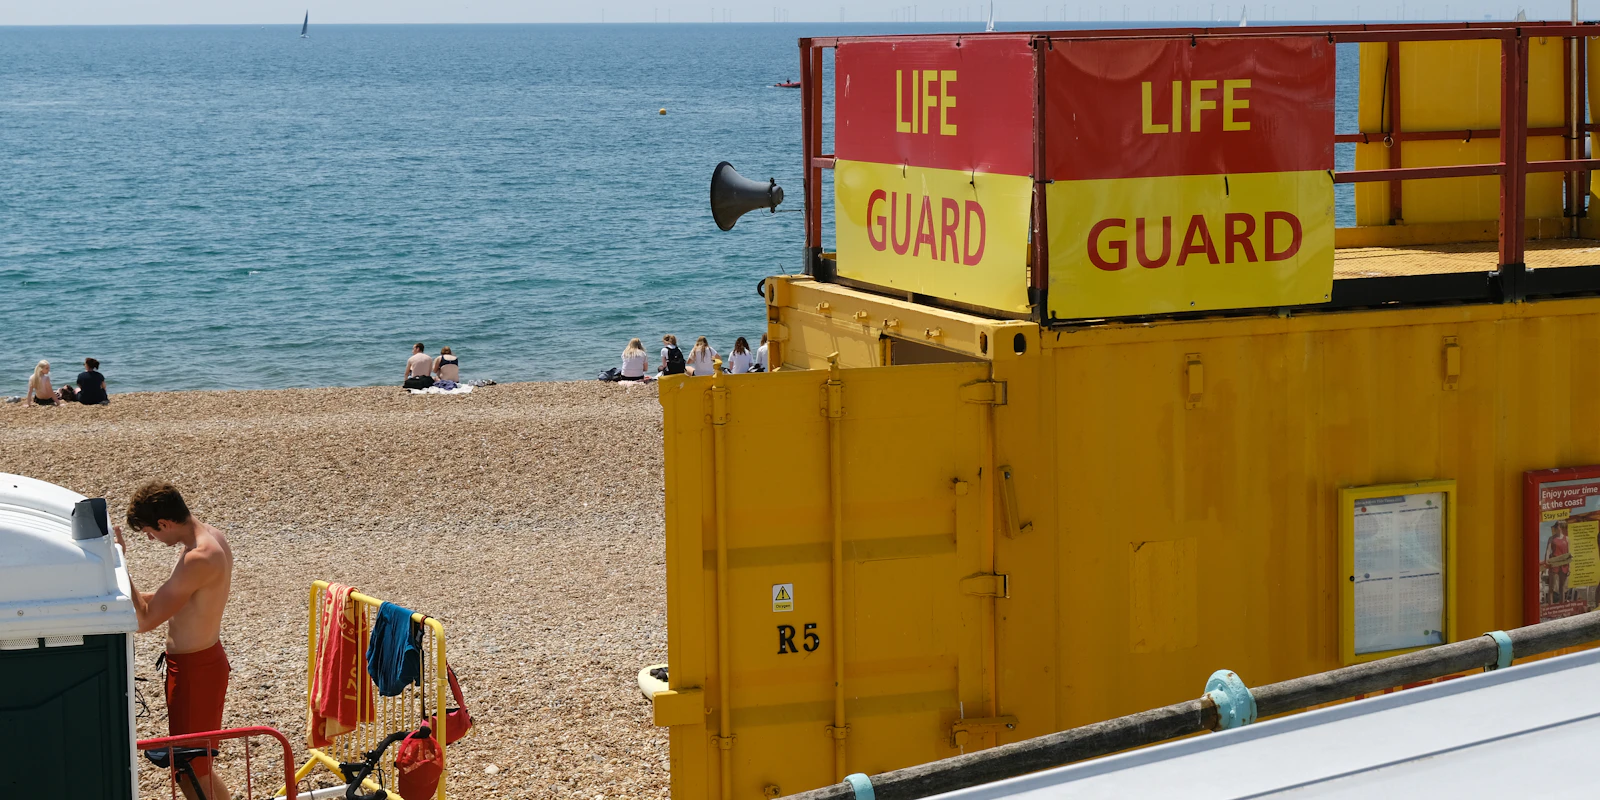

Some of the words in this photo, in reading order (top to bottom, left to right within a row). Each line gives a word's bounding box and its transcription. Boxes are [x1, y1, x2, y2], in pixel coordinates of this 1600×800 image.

[895, 69, 958, 136] LIFE
[1141, 78, 1252, 135] LIFE
[866, 189, 987, 267] GUARD
[1086, 210, 1304, 272] GUARD
[1542, 490, 1562, 500] Enjoy
[1563, 488, 1580, 498] your
[1582, 486, 1598, 494] time
[1542, 502, 1551, 510] at
[1551, 500, 1563, 508] the
[1564, 498, 1583, 507] coast
